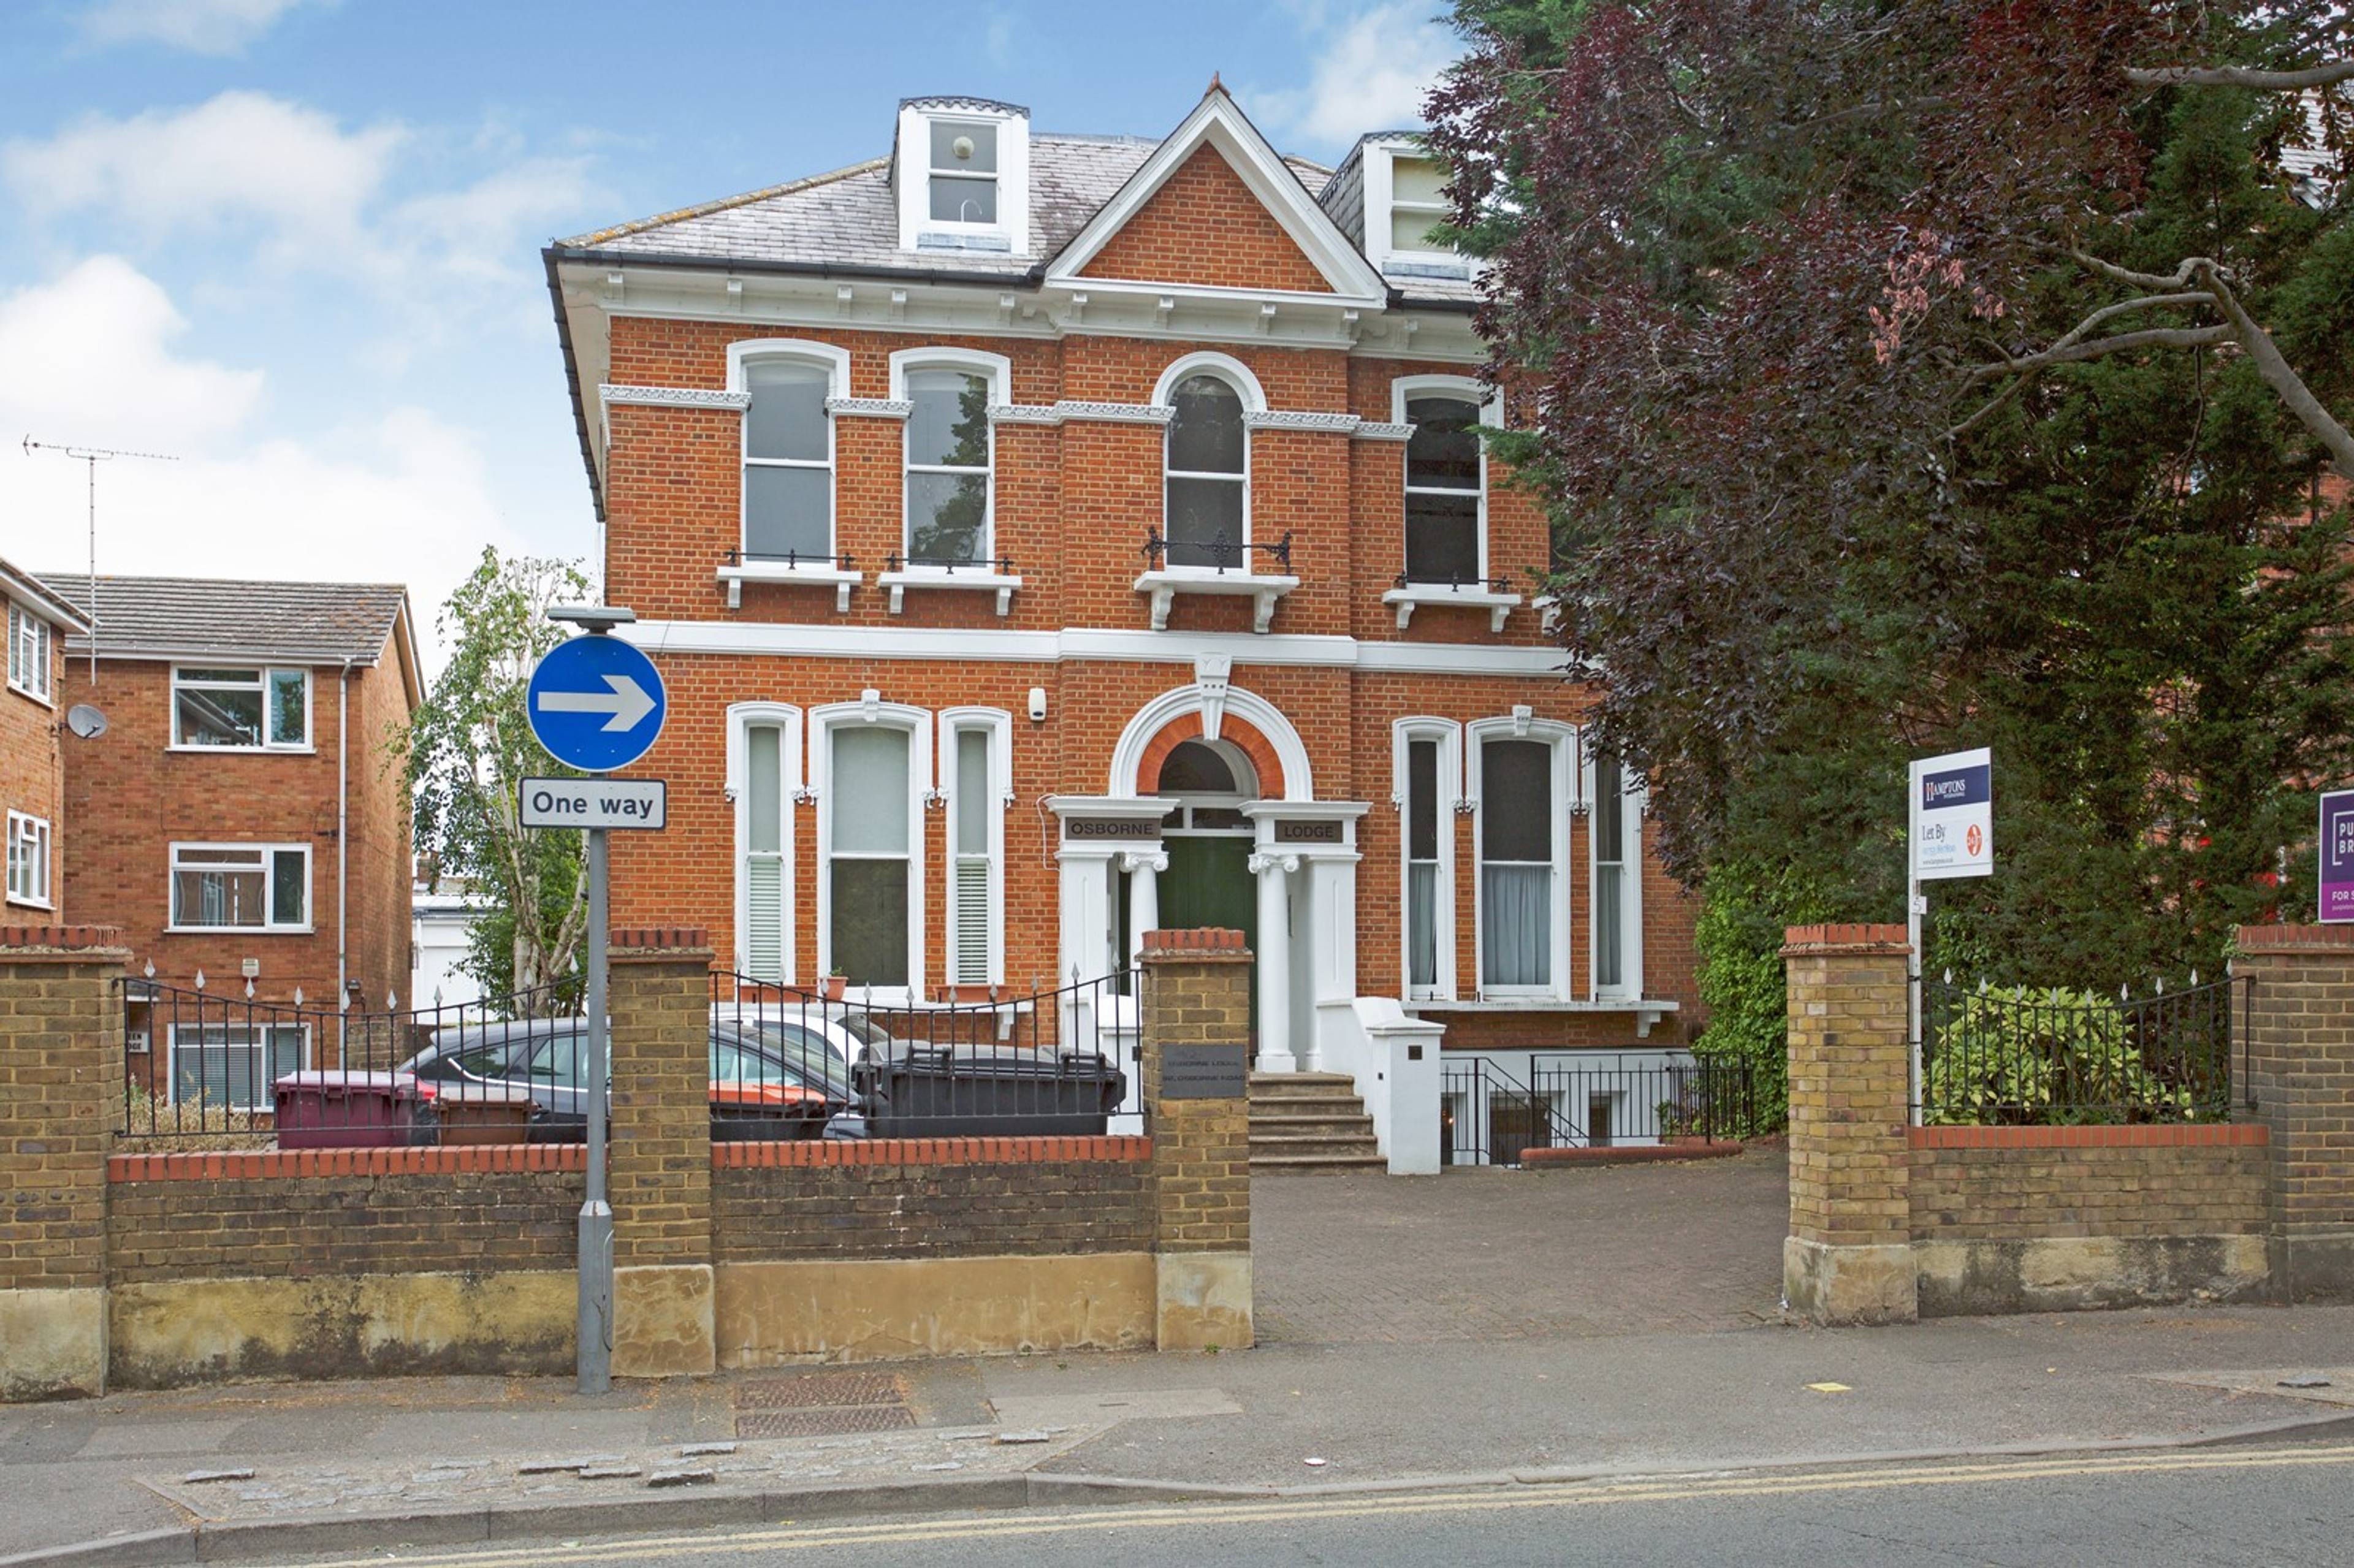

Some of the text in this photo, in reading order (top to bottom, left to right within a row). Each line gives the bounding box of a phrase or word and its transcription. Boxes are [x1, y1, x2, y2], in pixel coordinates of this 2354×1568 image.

[1926, 779, 1965, 801] HAMPTONS
[532, 791, 653, 819] One way
[1071, 823, 1153, 835] OSBORNE
[1284, 825, 1334, 838] LODGE
[1922, 824, 1946, 843] Let By
[2332, 891, 2349, 901] FOR
